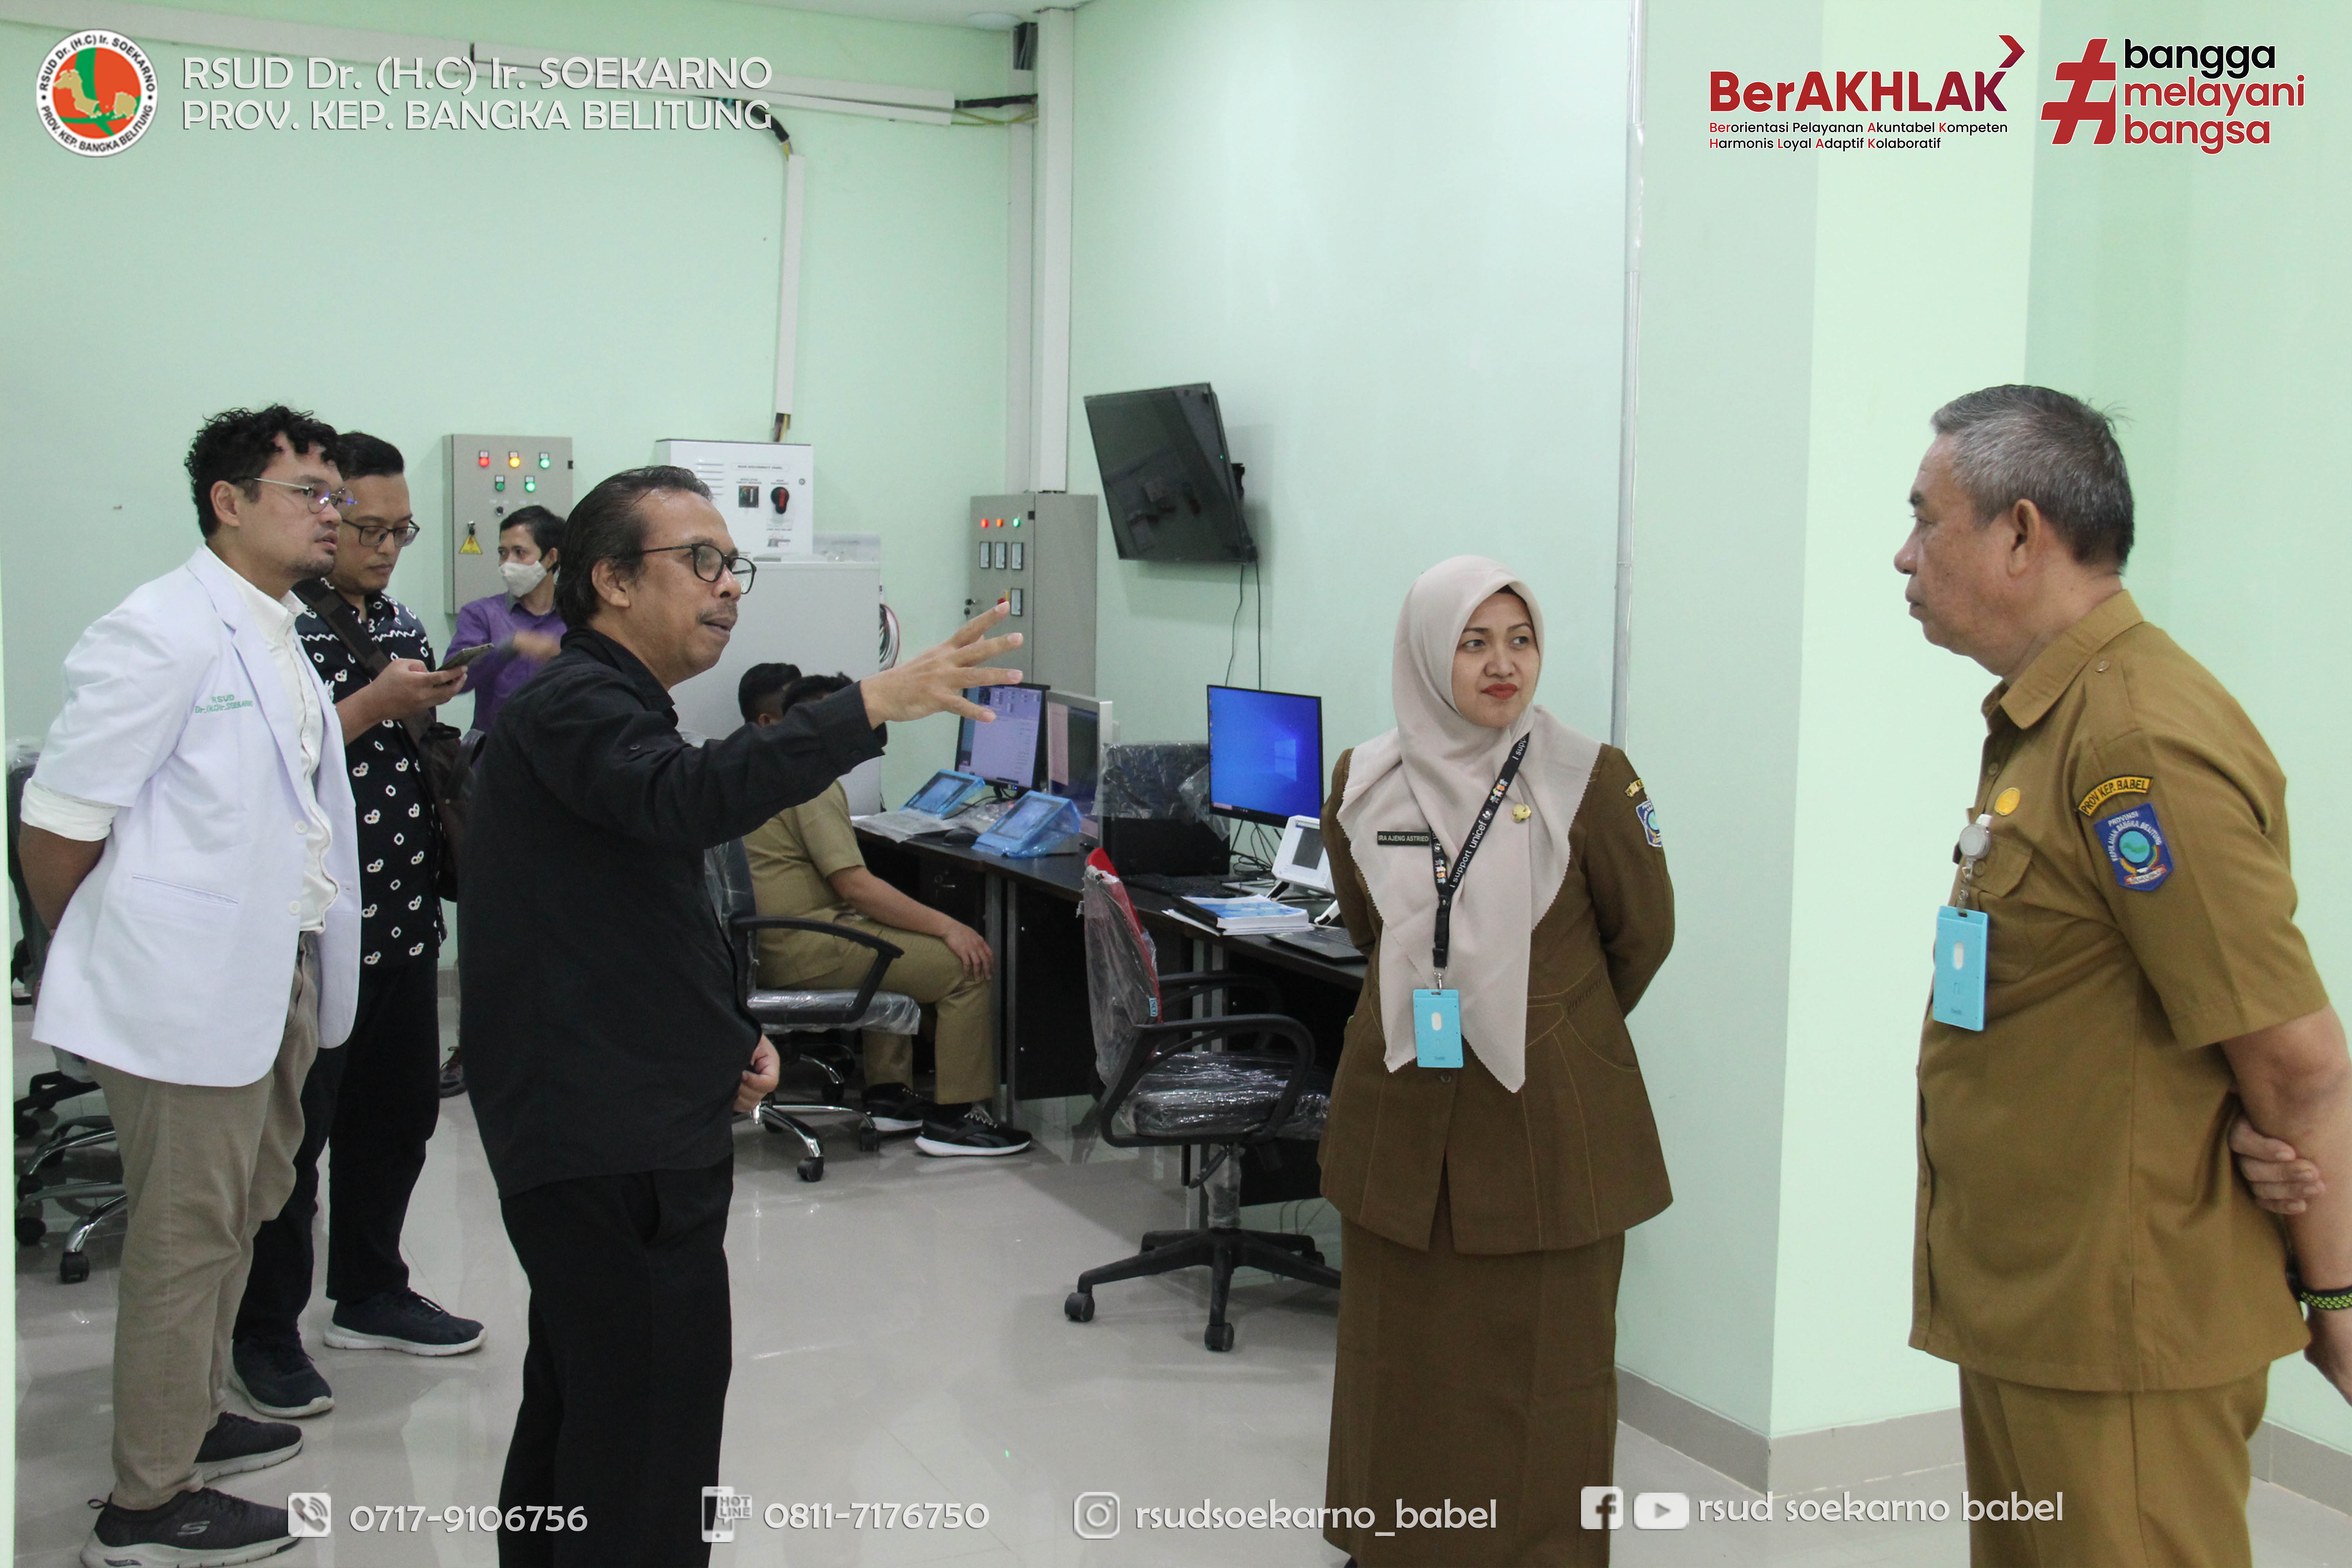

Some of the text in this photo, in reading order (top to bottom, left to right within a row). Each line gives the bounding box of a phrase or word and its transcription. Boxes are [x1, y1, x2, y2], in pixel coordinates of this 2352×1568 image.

[211, 694, 234, 703] RSUD
[1515, 737, 1527, 756] supp
[2117, 779, 2148, 790] BABEL
[2107, 811, 2139, 827] PROVINSI
[1453, 850, 1472, 883] support
[1469, 819, 1487, 849] unicef
